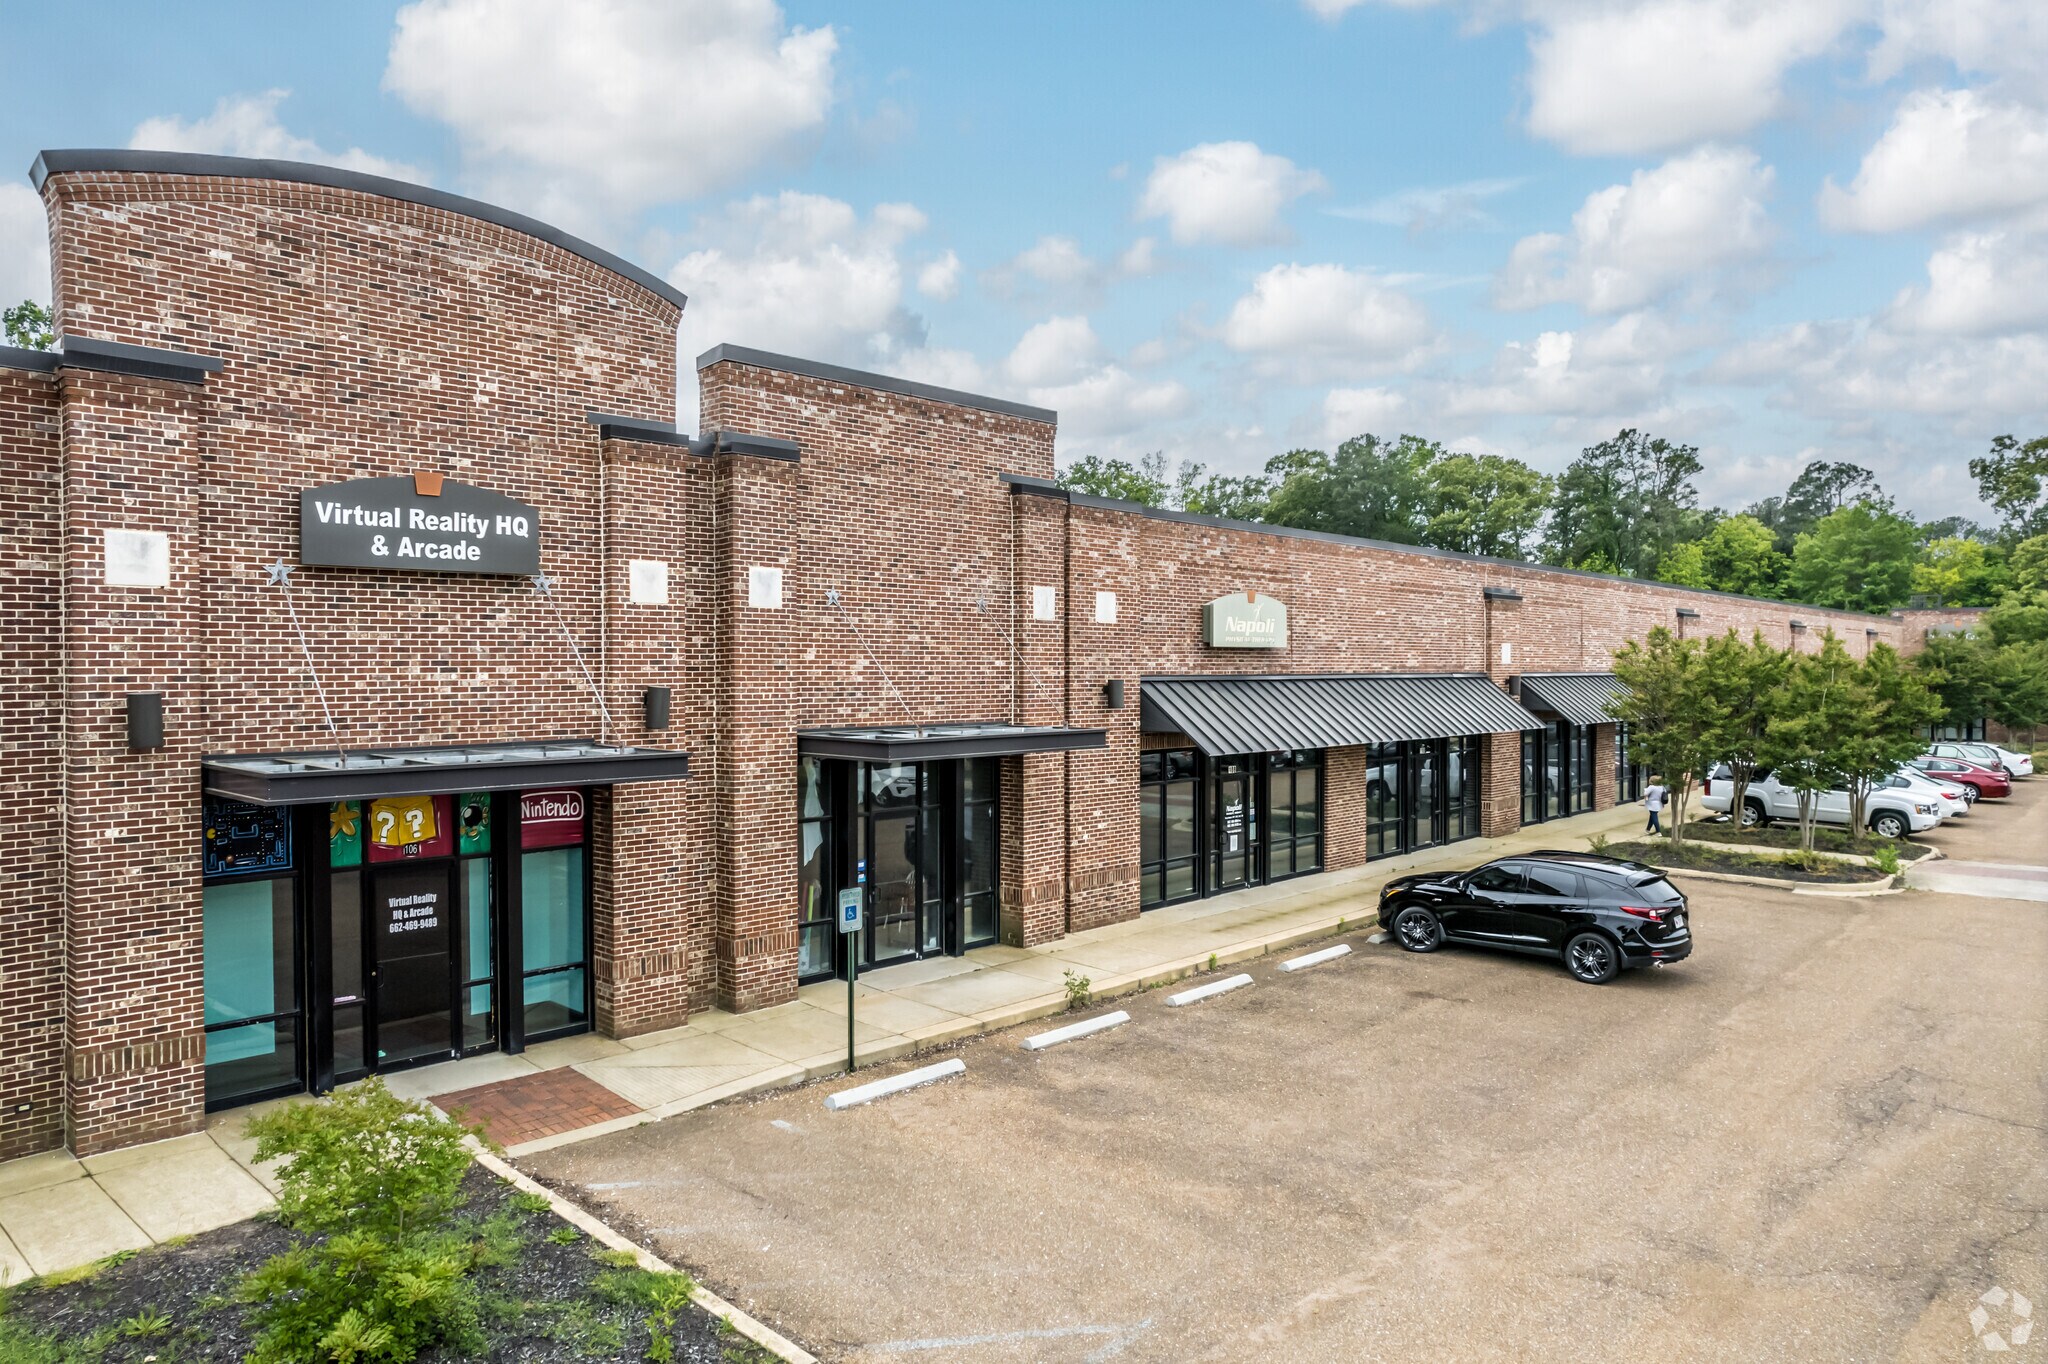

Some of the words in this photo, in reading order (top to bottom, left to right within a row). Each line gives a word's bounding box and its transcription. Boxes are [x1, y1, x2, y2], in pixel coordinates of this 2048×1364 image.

[315, 501, 400, 528] Virtual
[409, 508, 489, 538] Reality
[496, 515, 529, 538] HQ
[371, 534, 389, 556] &
[397, 536, 481, 561] Arcade
[1225, 616, 1275, 636] Napoli
[521, 794, 580, 818] Nintendo
[404, 844, 418, 854] 106
[389, 896, 412, 907] Virtual
[413, 893, 437, 904] Reality
[393, 910, 402, 920] HQ
[404, 910, 408, 918] &
[410, 906, 433, 917] Arcade
[390, 917, 437, 933] 662-469-9489
